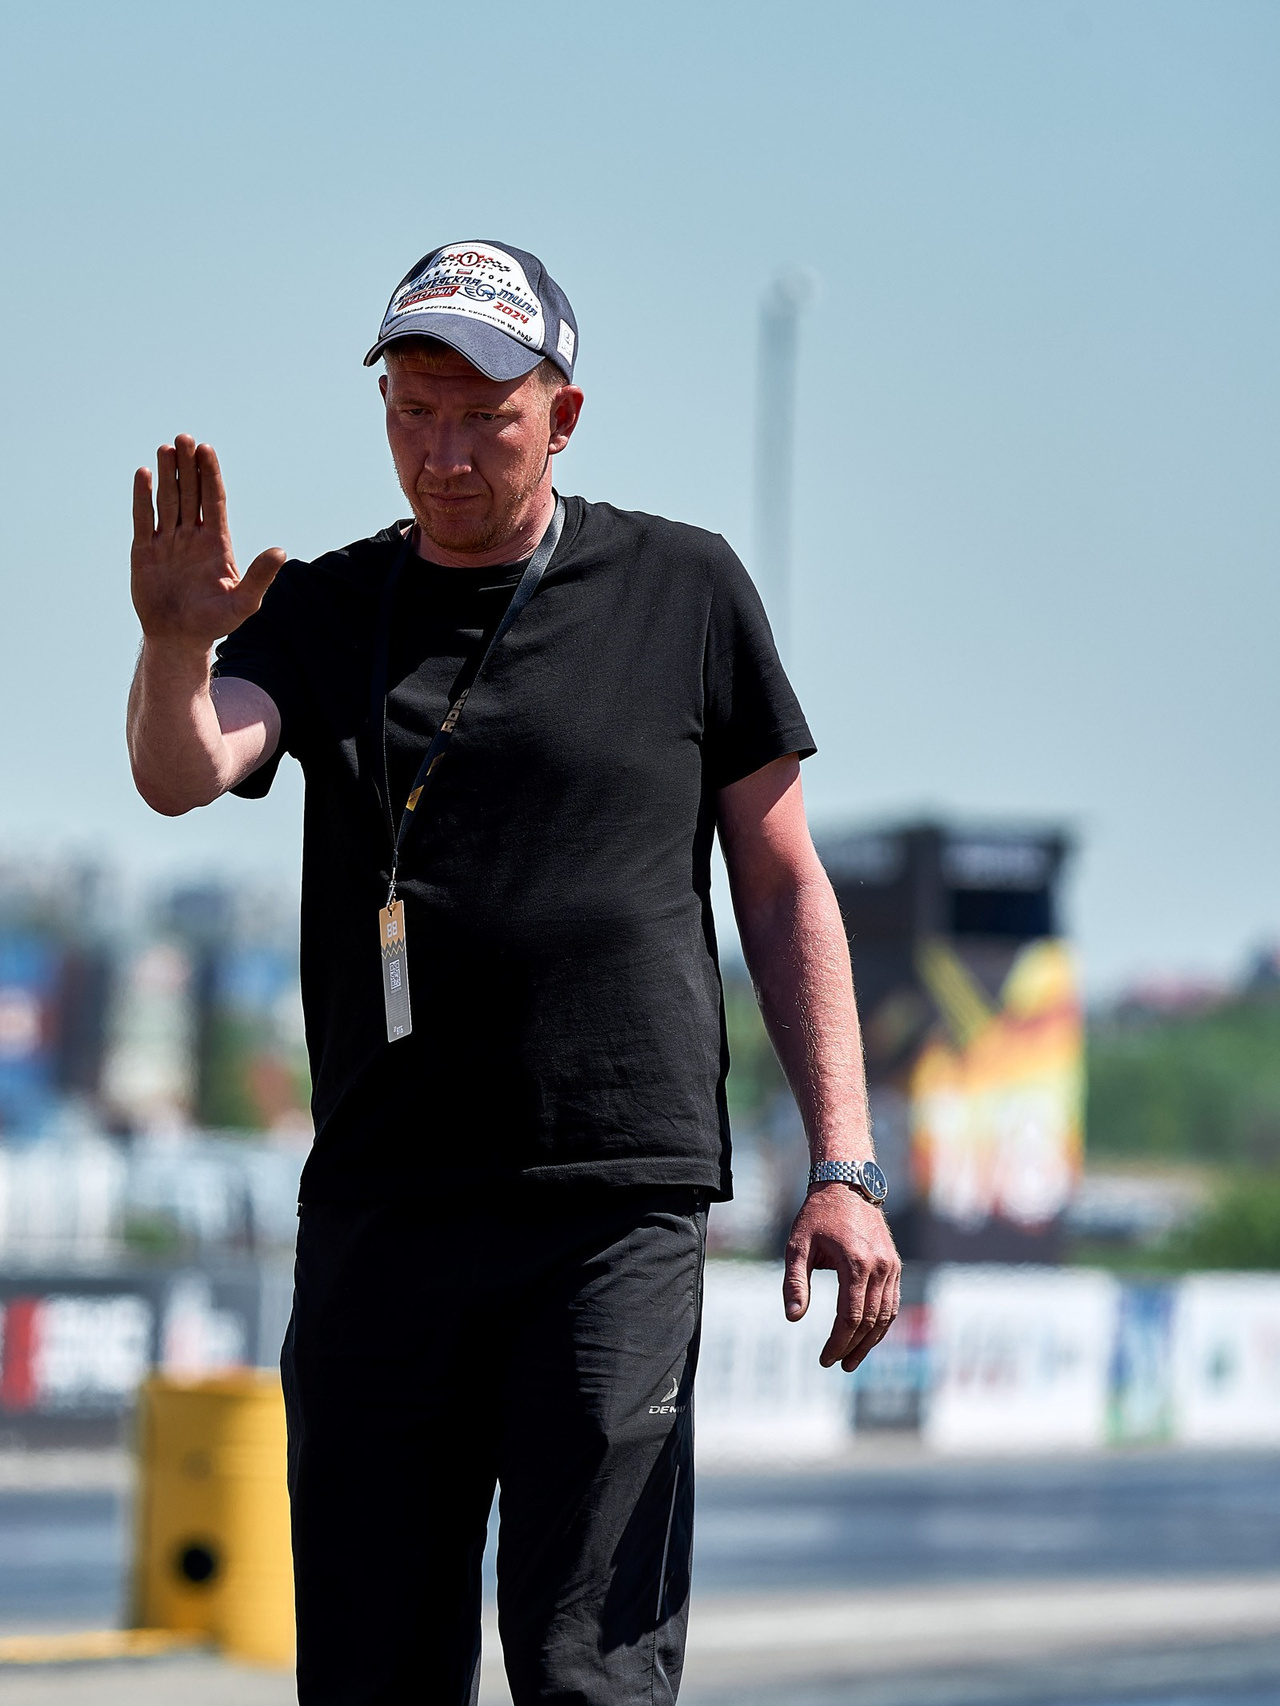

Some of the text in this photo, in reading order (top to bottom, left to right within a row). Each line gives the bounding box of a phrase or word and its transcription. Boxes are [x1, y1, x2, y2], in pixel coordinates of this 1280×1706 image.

[492, 301, 530, 325] 2024
[507, 322, 517, 332] НА
[516, 329, 533, 342] ЛЬДУ
